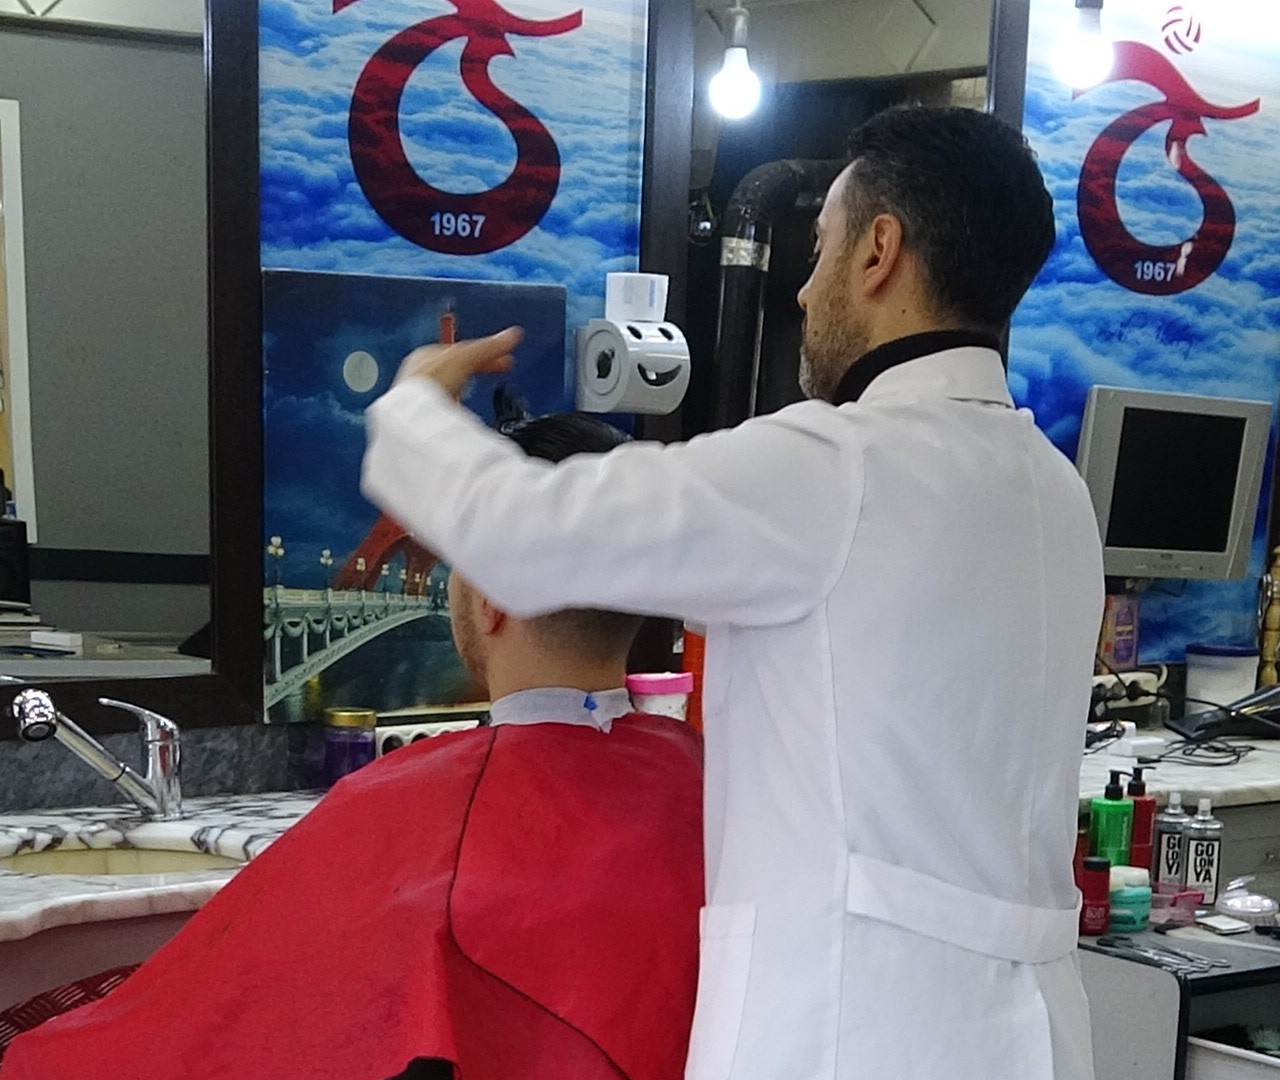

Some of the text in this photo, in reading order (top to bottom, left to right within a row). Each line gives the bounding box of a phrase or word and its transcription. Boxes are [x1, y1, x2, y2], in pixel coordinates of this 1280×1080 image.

[429, 211, 487, 238] 1967
[1134, 260, 1176, 282] 1967
[1194, 868, 1213, 883] YA
